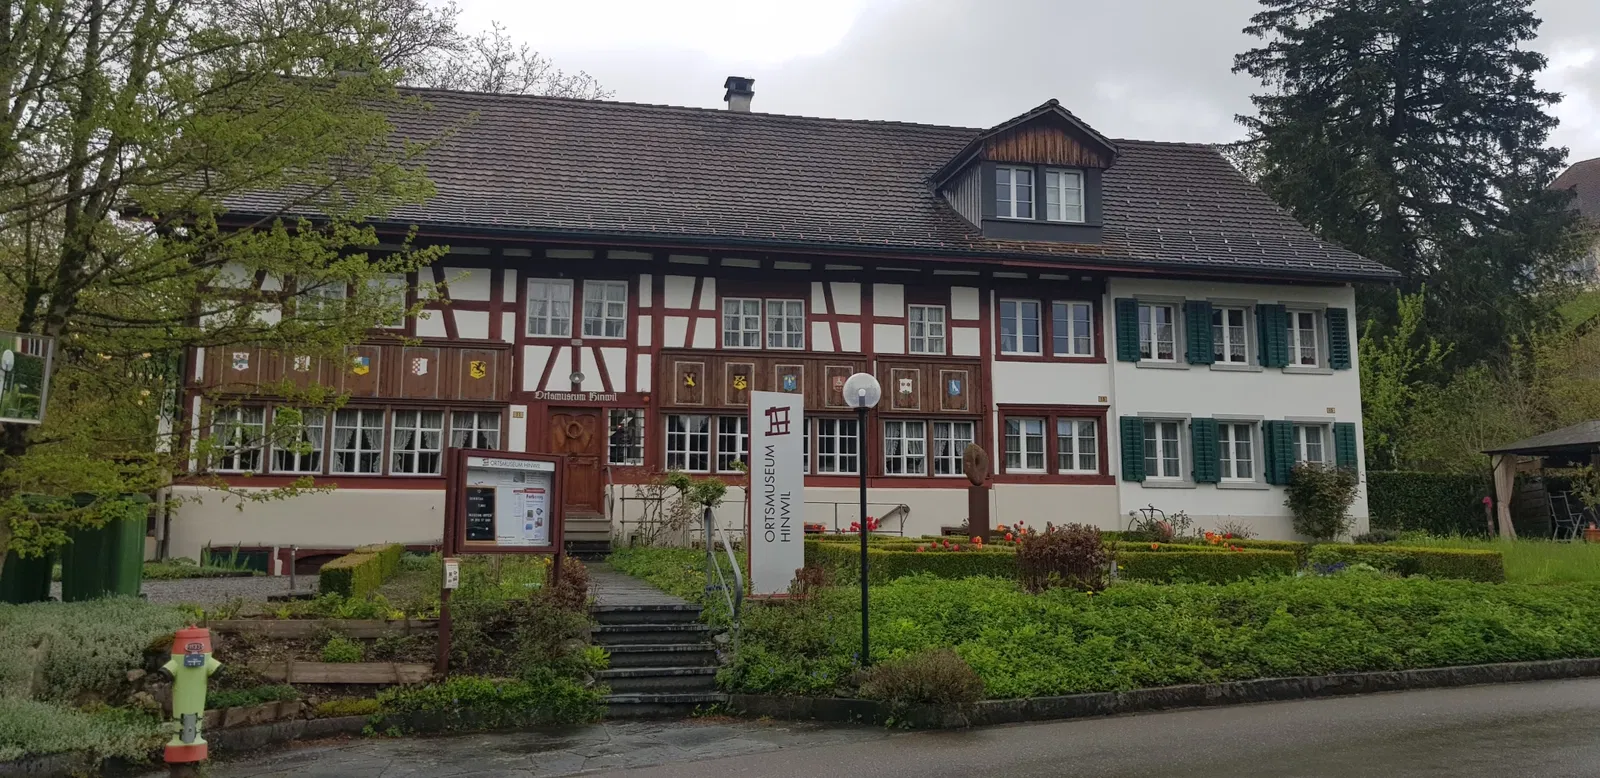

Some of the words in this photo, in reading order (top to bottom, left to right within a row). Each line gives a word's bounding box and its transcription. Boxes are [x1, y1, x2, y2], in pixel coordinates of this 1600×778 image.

[534, 390, 586, 401] Ortsmuseum
[588, 391, 618, 402] Hinwil
[490, 460, 523, 468] ORTSMUSEUM
[765, 444, 775, 543] ORTSMUSEUM
[780, 490, 791, 543] HINWIL
